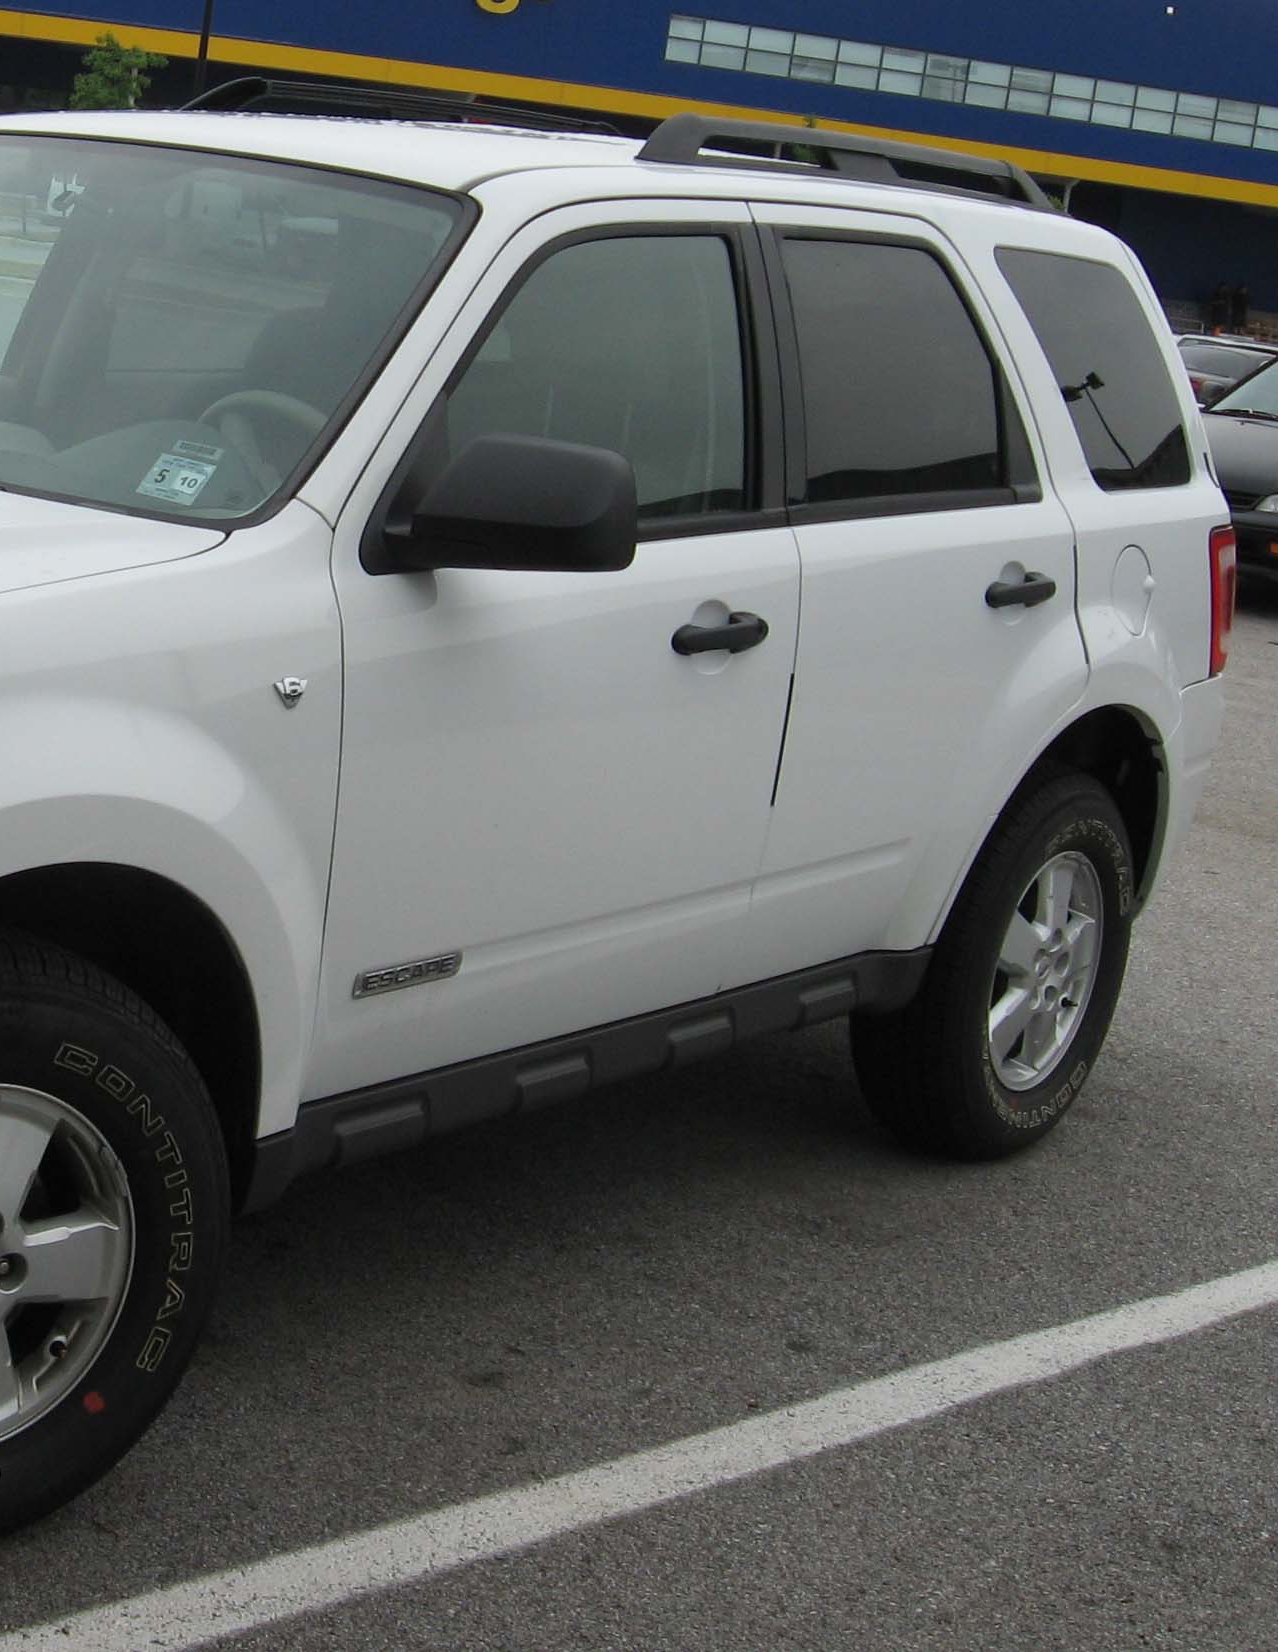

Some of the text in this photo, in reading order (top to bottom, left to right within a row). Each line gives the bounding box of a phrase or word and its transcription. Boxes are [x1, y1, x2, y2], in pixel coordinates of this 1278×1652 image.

[153, 468, 199, 489] 5 10
[361, 952, 457, 991] ESCAPE
[53, 1040, 194, 1372] CONTITRAC
